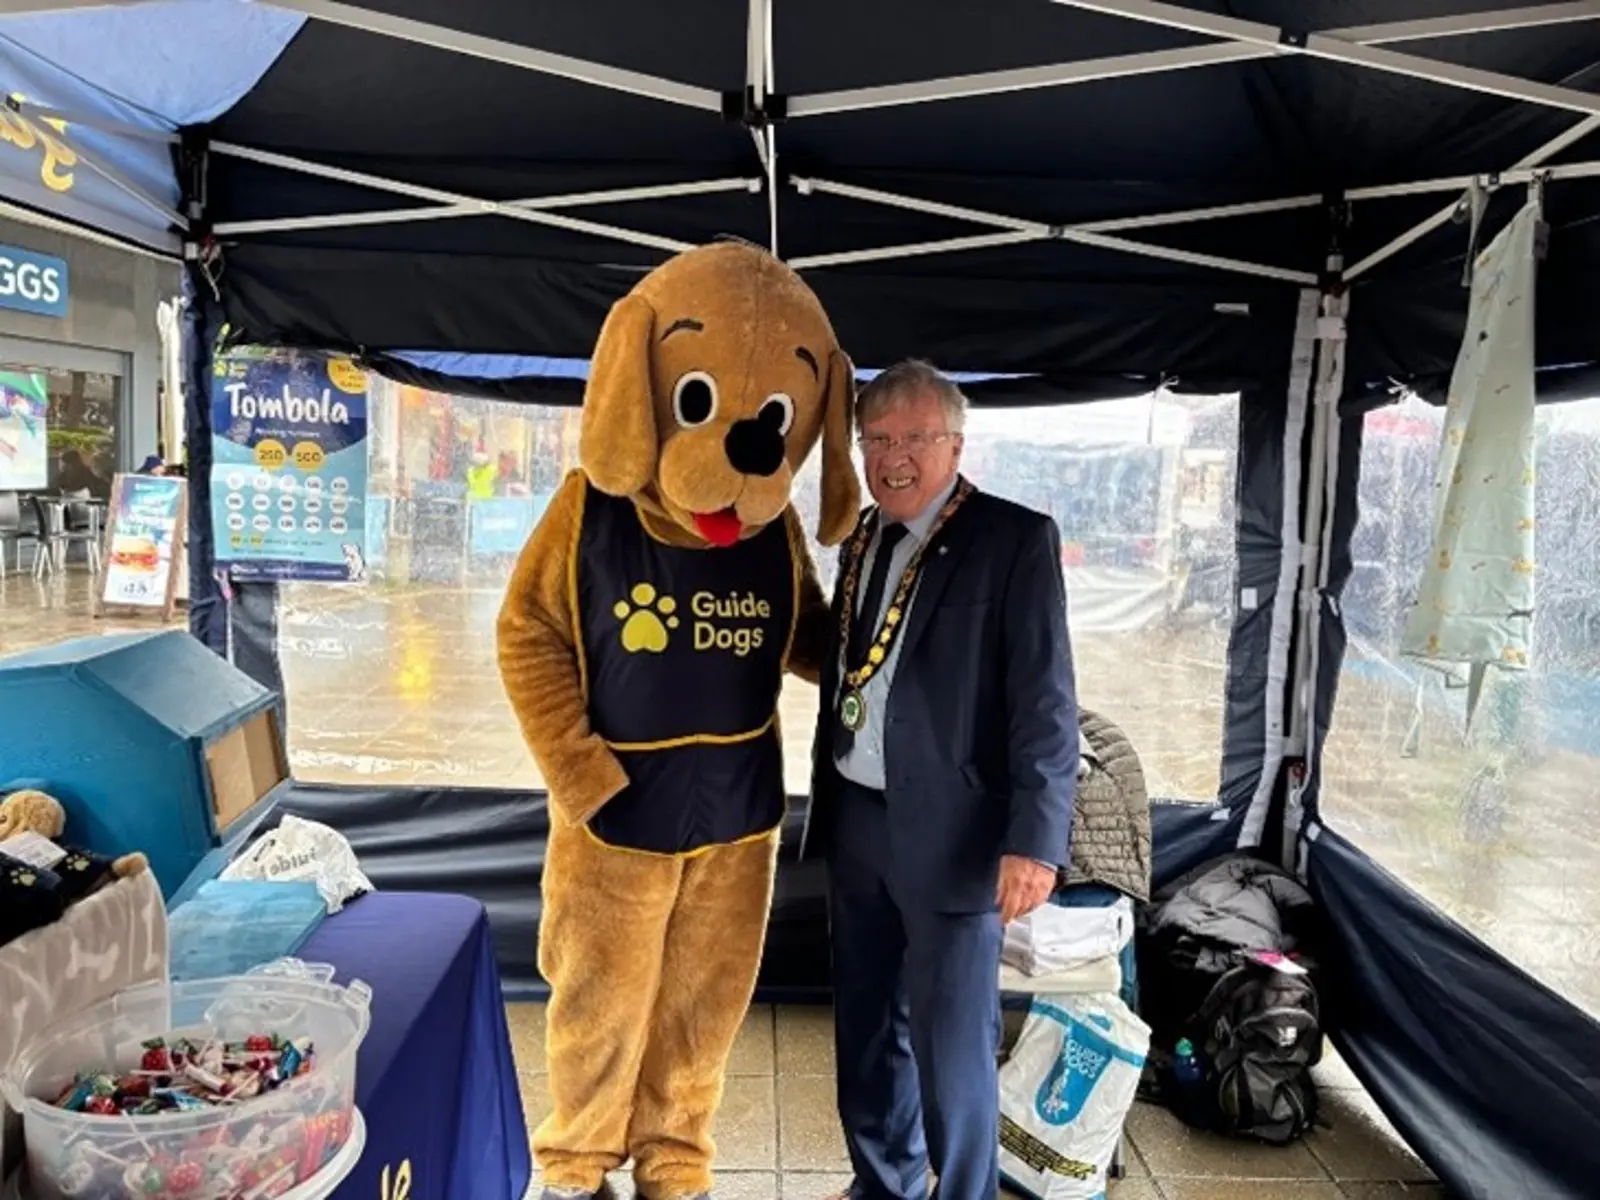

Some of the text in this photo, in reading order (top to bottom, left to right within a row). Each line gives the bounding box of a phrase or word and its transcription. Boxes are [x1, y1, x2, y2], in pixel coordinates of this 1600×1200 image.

[223, 382, 349, 425] Tombola
[691, 591, 771, 618] Guide
[693, 621, 764, 657] Dogs
